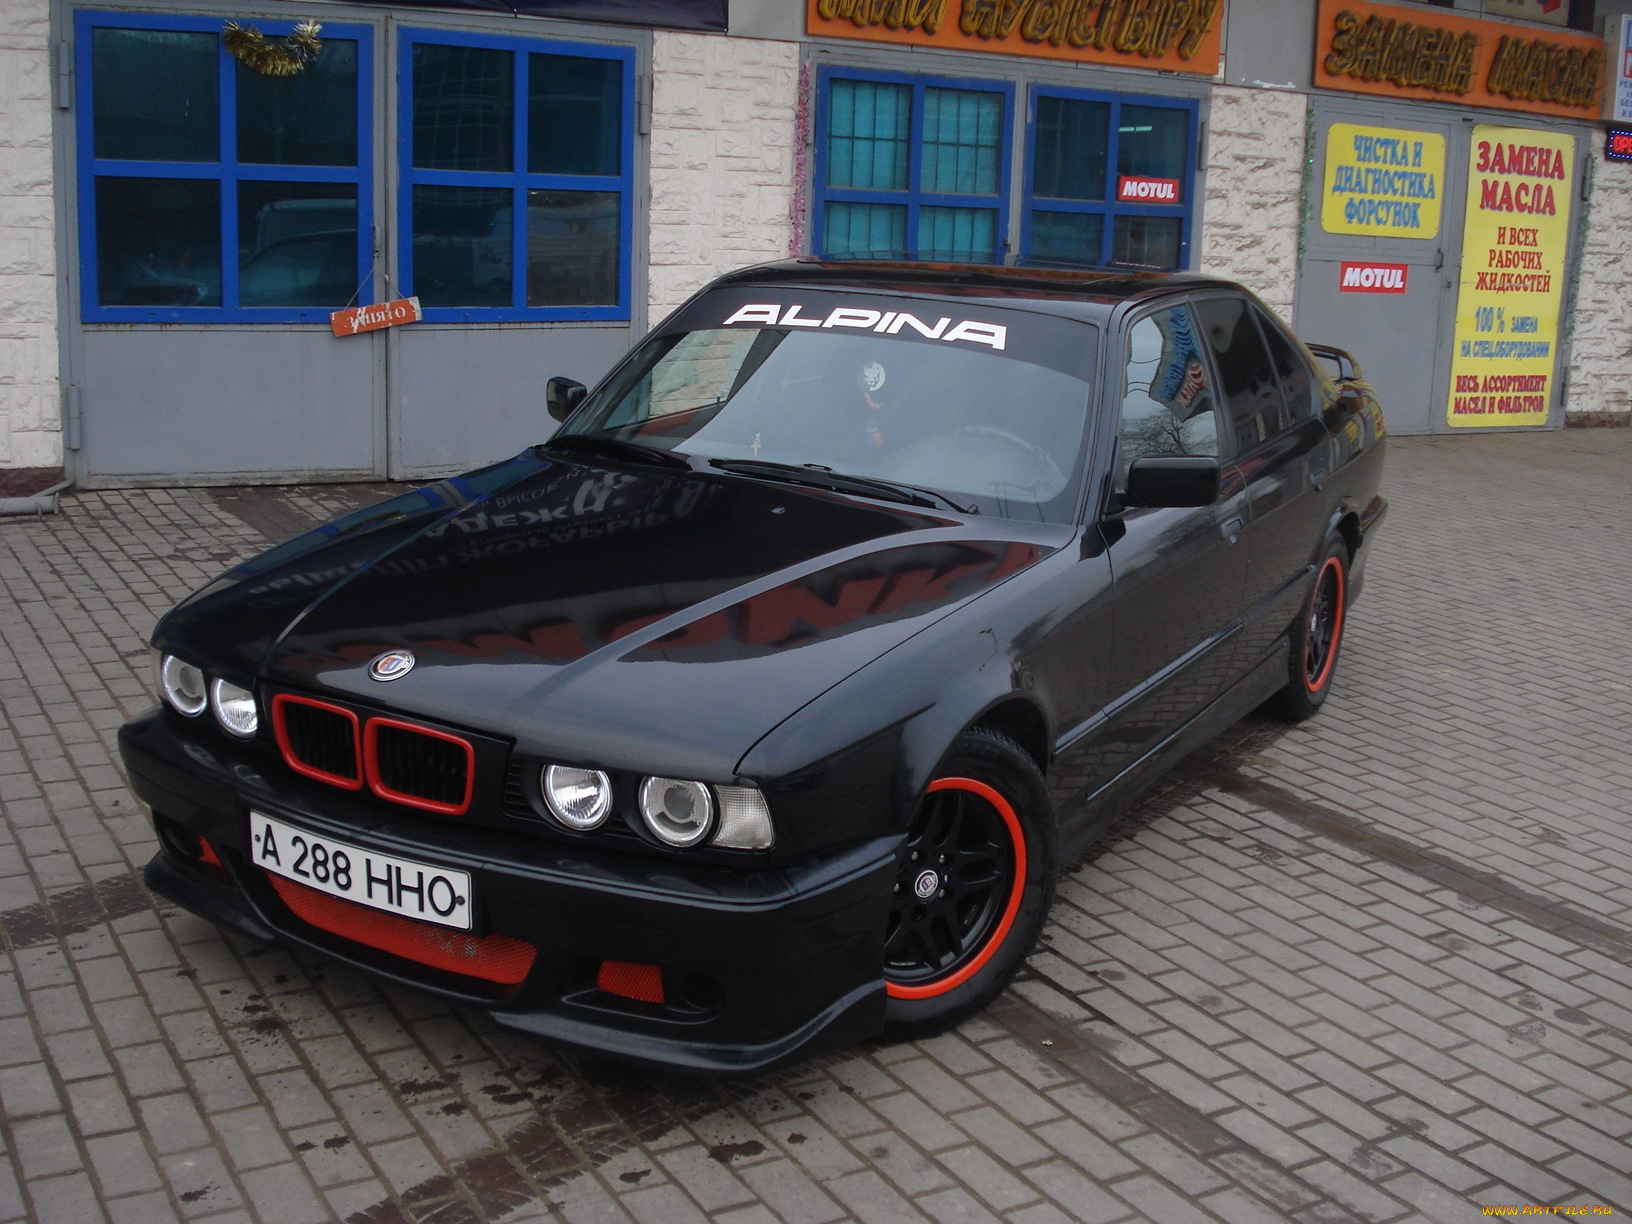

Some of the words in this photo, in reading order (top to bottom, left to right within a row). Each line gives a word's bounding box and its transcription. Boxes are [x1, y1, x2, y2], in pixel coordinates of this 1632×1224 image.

[1325, 9, 1479, 96] ЗАМЕНА
[1354, 135, 1409, 167] ЧИСТКА
[1412, 141, 1423, 167] И
[1476, 141, 1565, 180] ЗАМЕНА
[1122, 181, 1175, 199] MOTUL
[1332, 164, 1436, 200] ДИАГНОСТИКА
[1479, 179, 1556, 216] МАСЛА
[1345, 197, 1421, 229] ФОРСУНОК
[1497, 226, 1506, 245] И
[1509, 227, 1539, 247] ВСЕХ
[1488, 249, 1543, 270] РАБОЧИХ
[1342, 267, 1405, 288] MOTUL
[1475, 269, 1551, 294] ЖИДКОСТЕЙ
[722, 304, 1007, 350] ALPINA
[1475, 306, 1494, 332] 100
[1511, 316, 1538, 333] ЗАМЕНА
[1460, 340, 1471, 357] НА
[1456, 375, 1479, 393] ВЕСЬ
[1481, 375, 1547, 393] АССОРТИМЕНТ
[1453, 396, 1486, 414] МАСЕЛ
[1488, 396, 1496, 414] И
[1497, 395, 1544, 414] ФИЛЬТРОВ
[261, 824, 281, 867] A
[291, 835, 352, 891] 288
